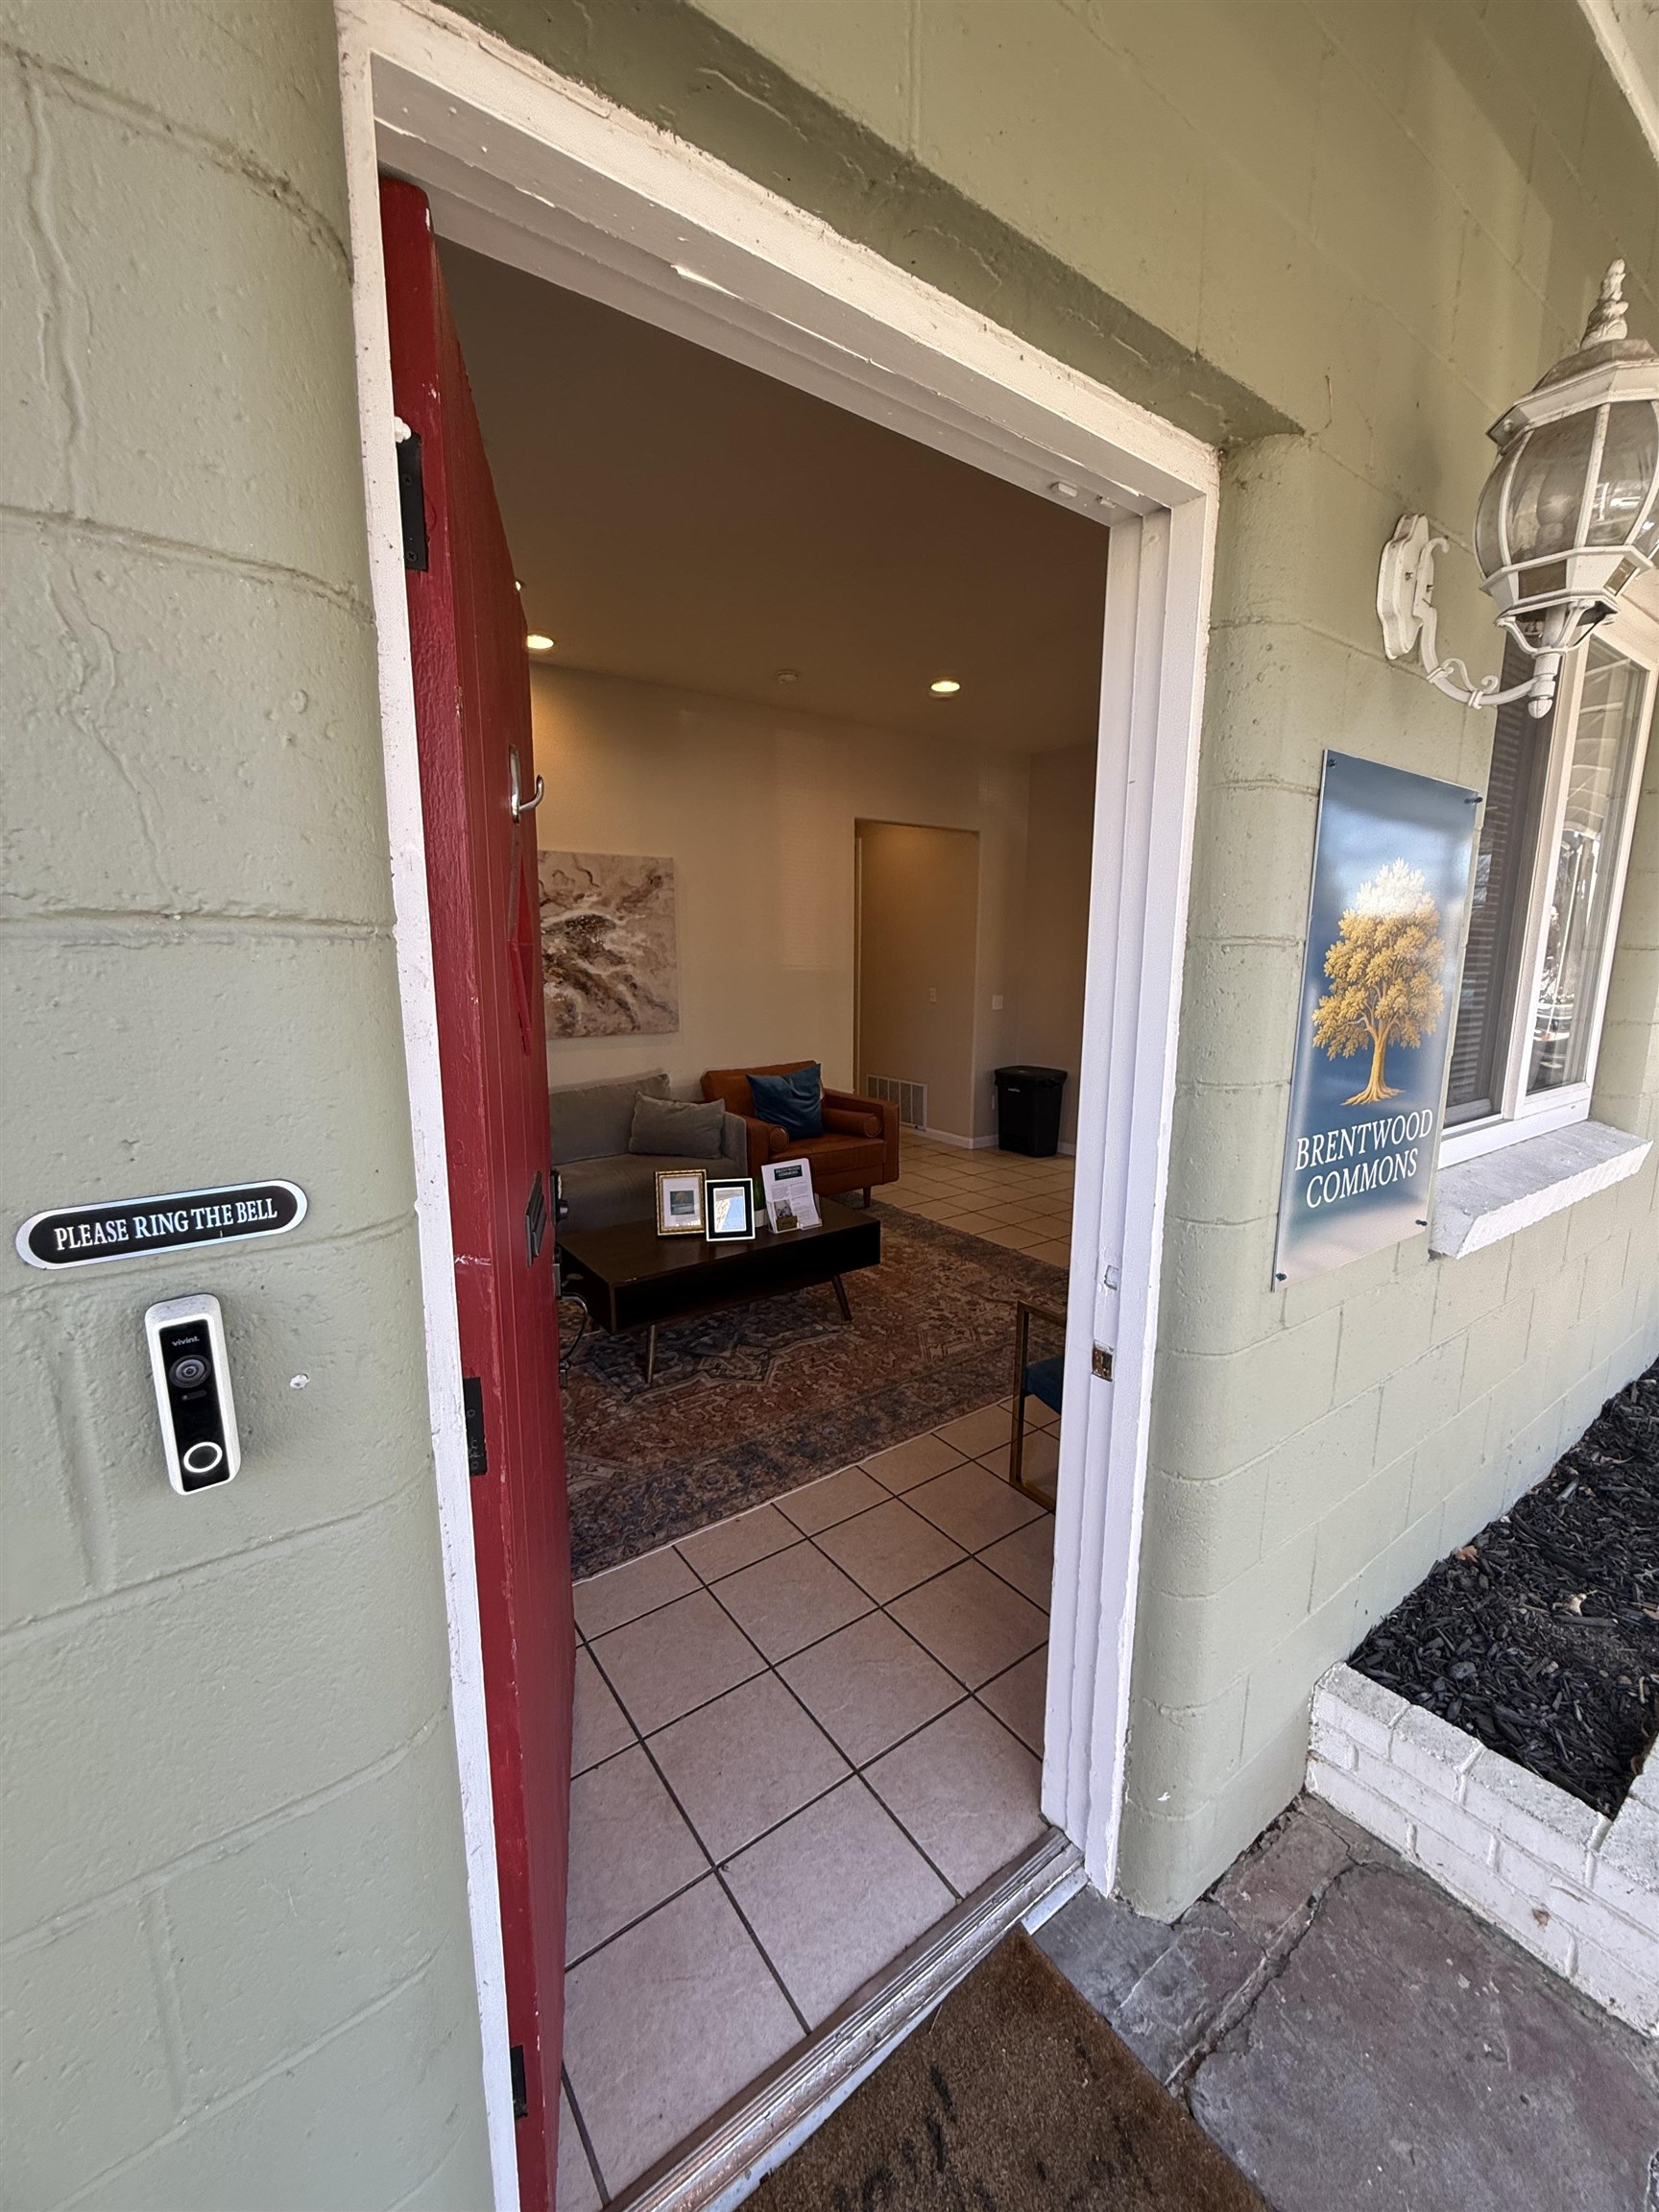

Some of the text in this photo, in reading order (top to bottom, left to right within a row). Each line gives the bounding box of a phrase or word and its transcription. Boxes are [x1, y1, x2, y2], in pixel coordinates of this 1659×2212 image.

[1295, 1109, 1433, 1171] BRENTWOOD
[1307, 1148, 1418, 1209] COMMONS
[54, 1197, 278, 1251] PLEASE RING THE BELL
